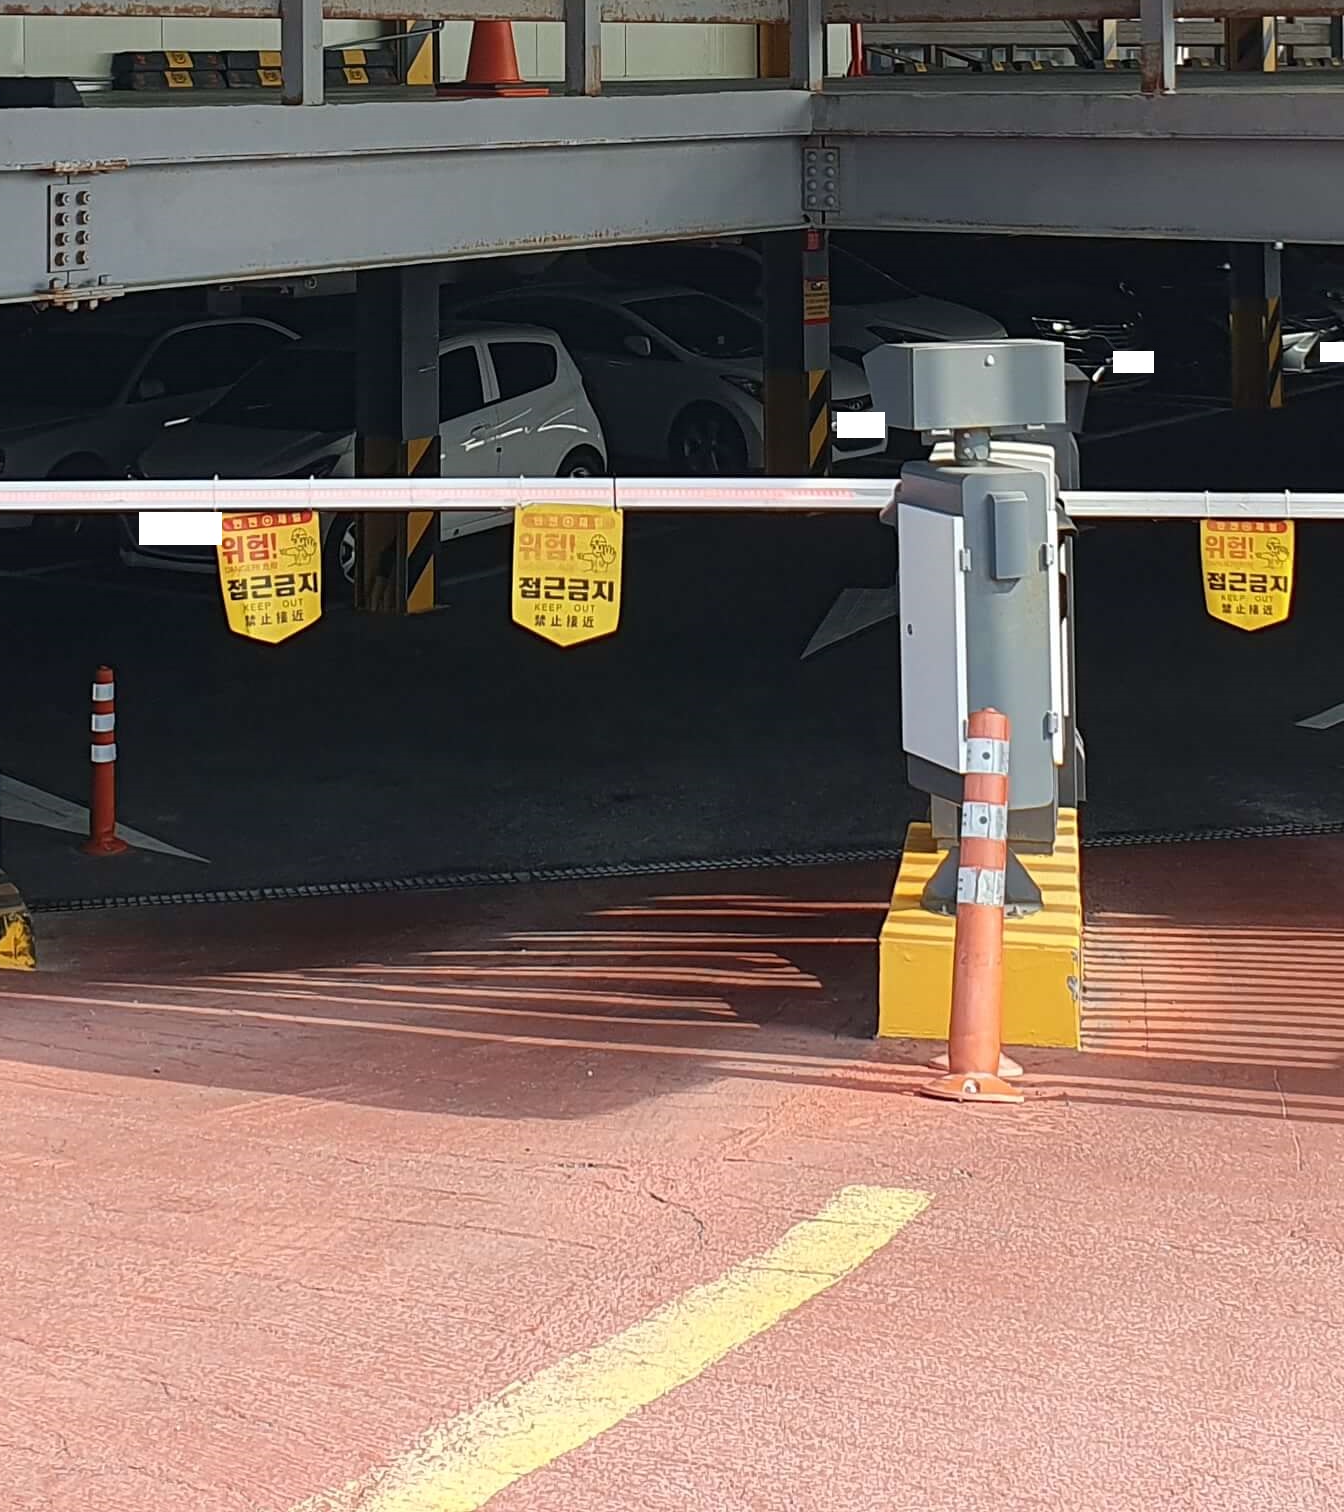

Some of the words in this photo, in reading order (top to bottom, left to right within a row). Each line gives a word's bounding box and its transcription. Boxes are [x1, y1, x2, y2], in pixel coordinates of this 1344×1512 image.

[221, 532, 278, 565] 위험!
[518, 532, 577, 561] 위험!
[1205, 535, 1254, 560] 위험!
[226, 571, 319, 601] 접근금지
[518, 576, 615, 603] 접근금지
[1207, 571, 1288, 594] 접근금지
[242, 601, 272, 612] KEEP
[281, 598, 304, 609] OUT
[534, 603, 563, 613] KEEP
[573, 603, 596, 613] OUT
